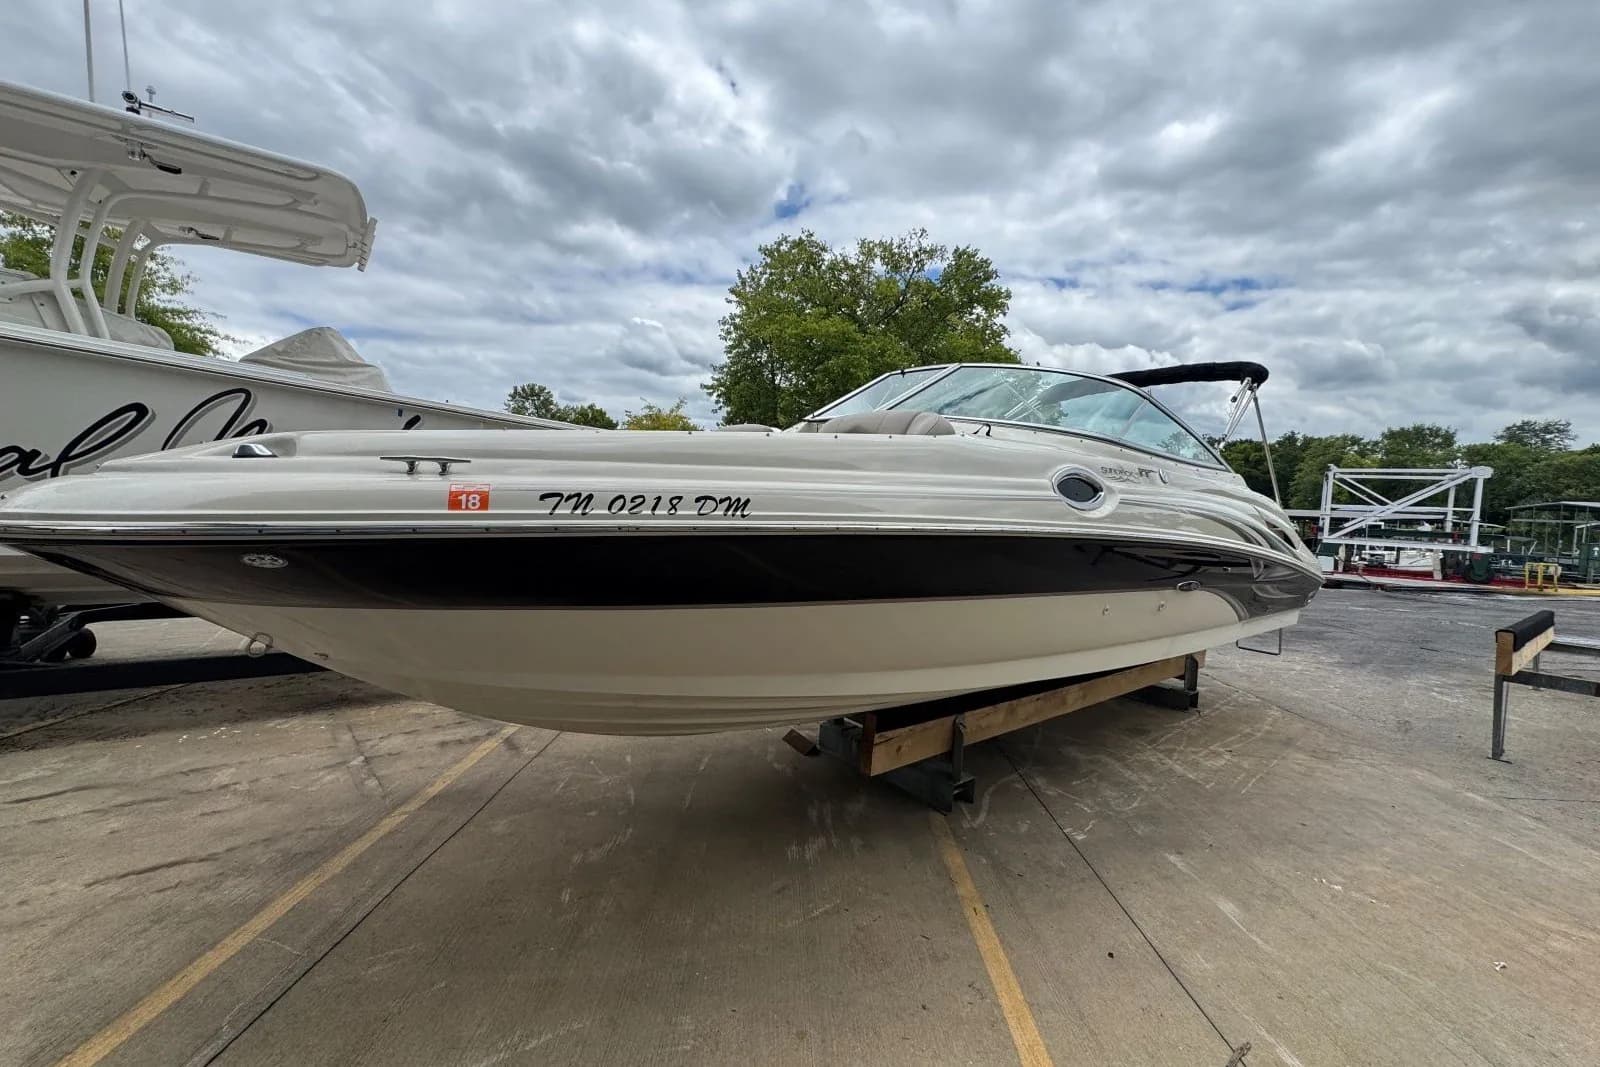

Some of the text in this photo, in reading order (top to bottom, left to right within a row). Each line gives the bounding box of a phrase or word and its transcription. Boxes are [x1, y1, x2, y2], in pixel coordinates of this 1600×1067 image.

[458, 494, 480, 510] 18
[539, 492, 752, 518] TN 0218 DM
